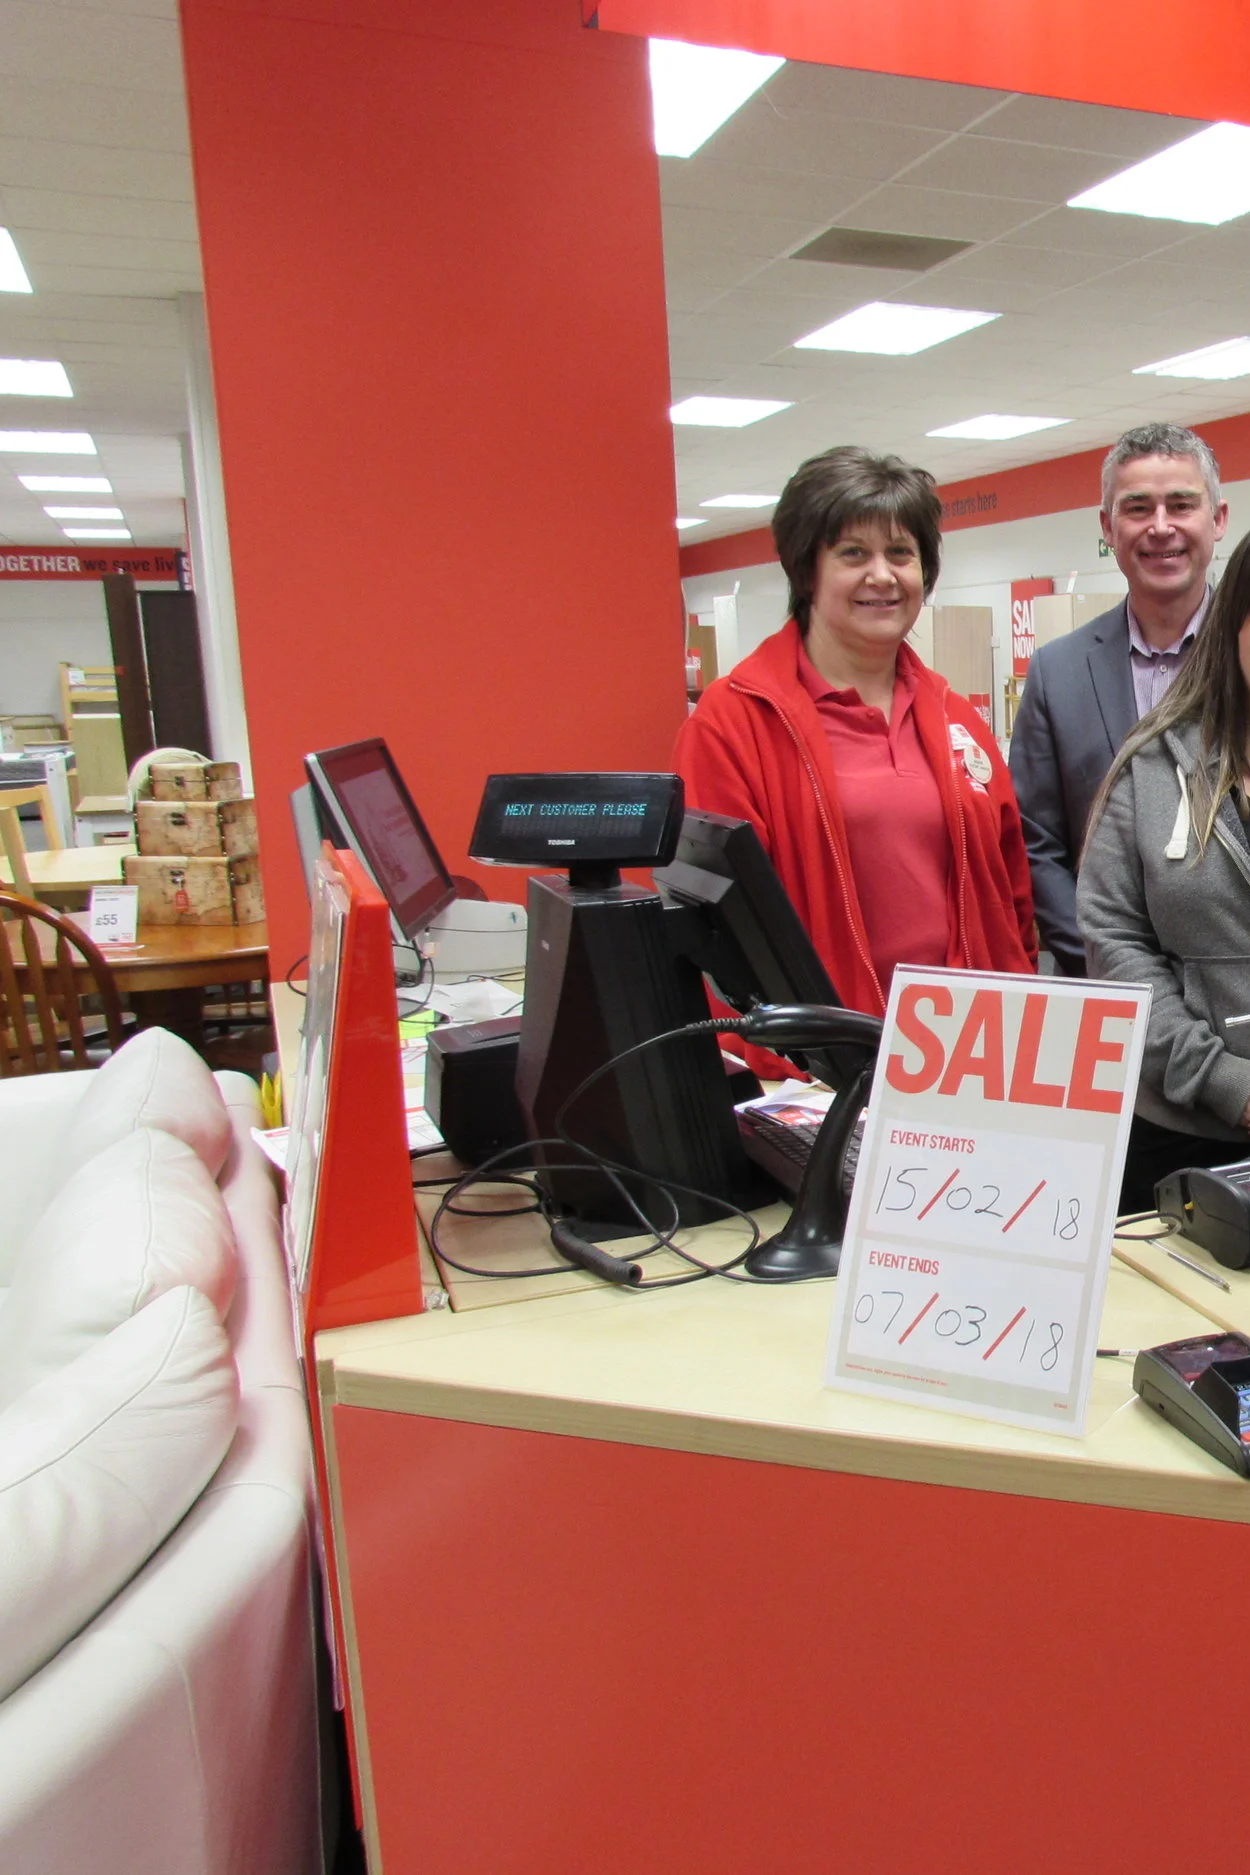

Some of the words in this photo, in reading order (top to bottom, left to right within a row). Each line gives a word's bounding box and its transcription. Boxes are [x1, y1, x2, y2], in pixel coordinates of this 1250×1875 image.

[951, 498, 976, 515] starts
[977, 491, 998, 512] here
[84, 558, 106, 571] we
[112, 559, 149, 571] save
[505, 803, 534, 815] NEXT
[540, 803, 596, 815] CUSTOMER
[602, 803, 647, 815] PLEASE
[96, 914, 118, 926] £55
[886, 984, 1138, 1113] SALE
[890, 1130, 929, 1148] EVENT
[930, 1135, 975, 1153] STARTS
[869, 1250, 909, 1270] EVENT
[908, 1256, 939, 1275] ENDS
